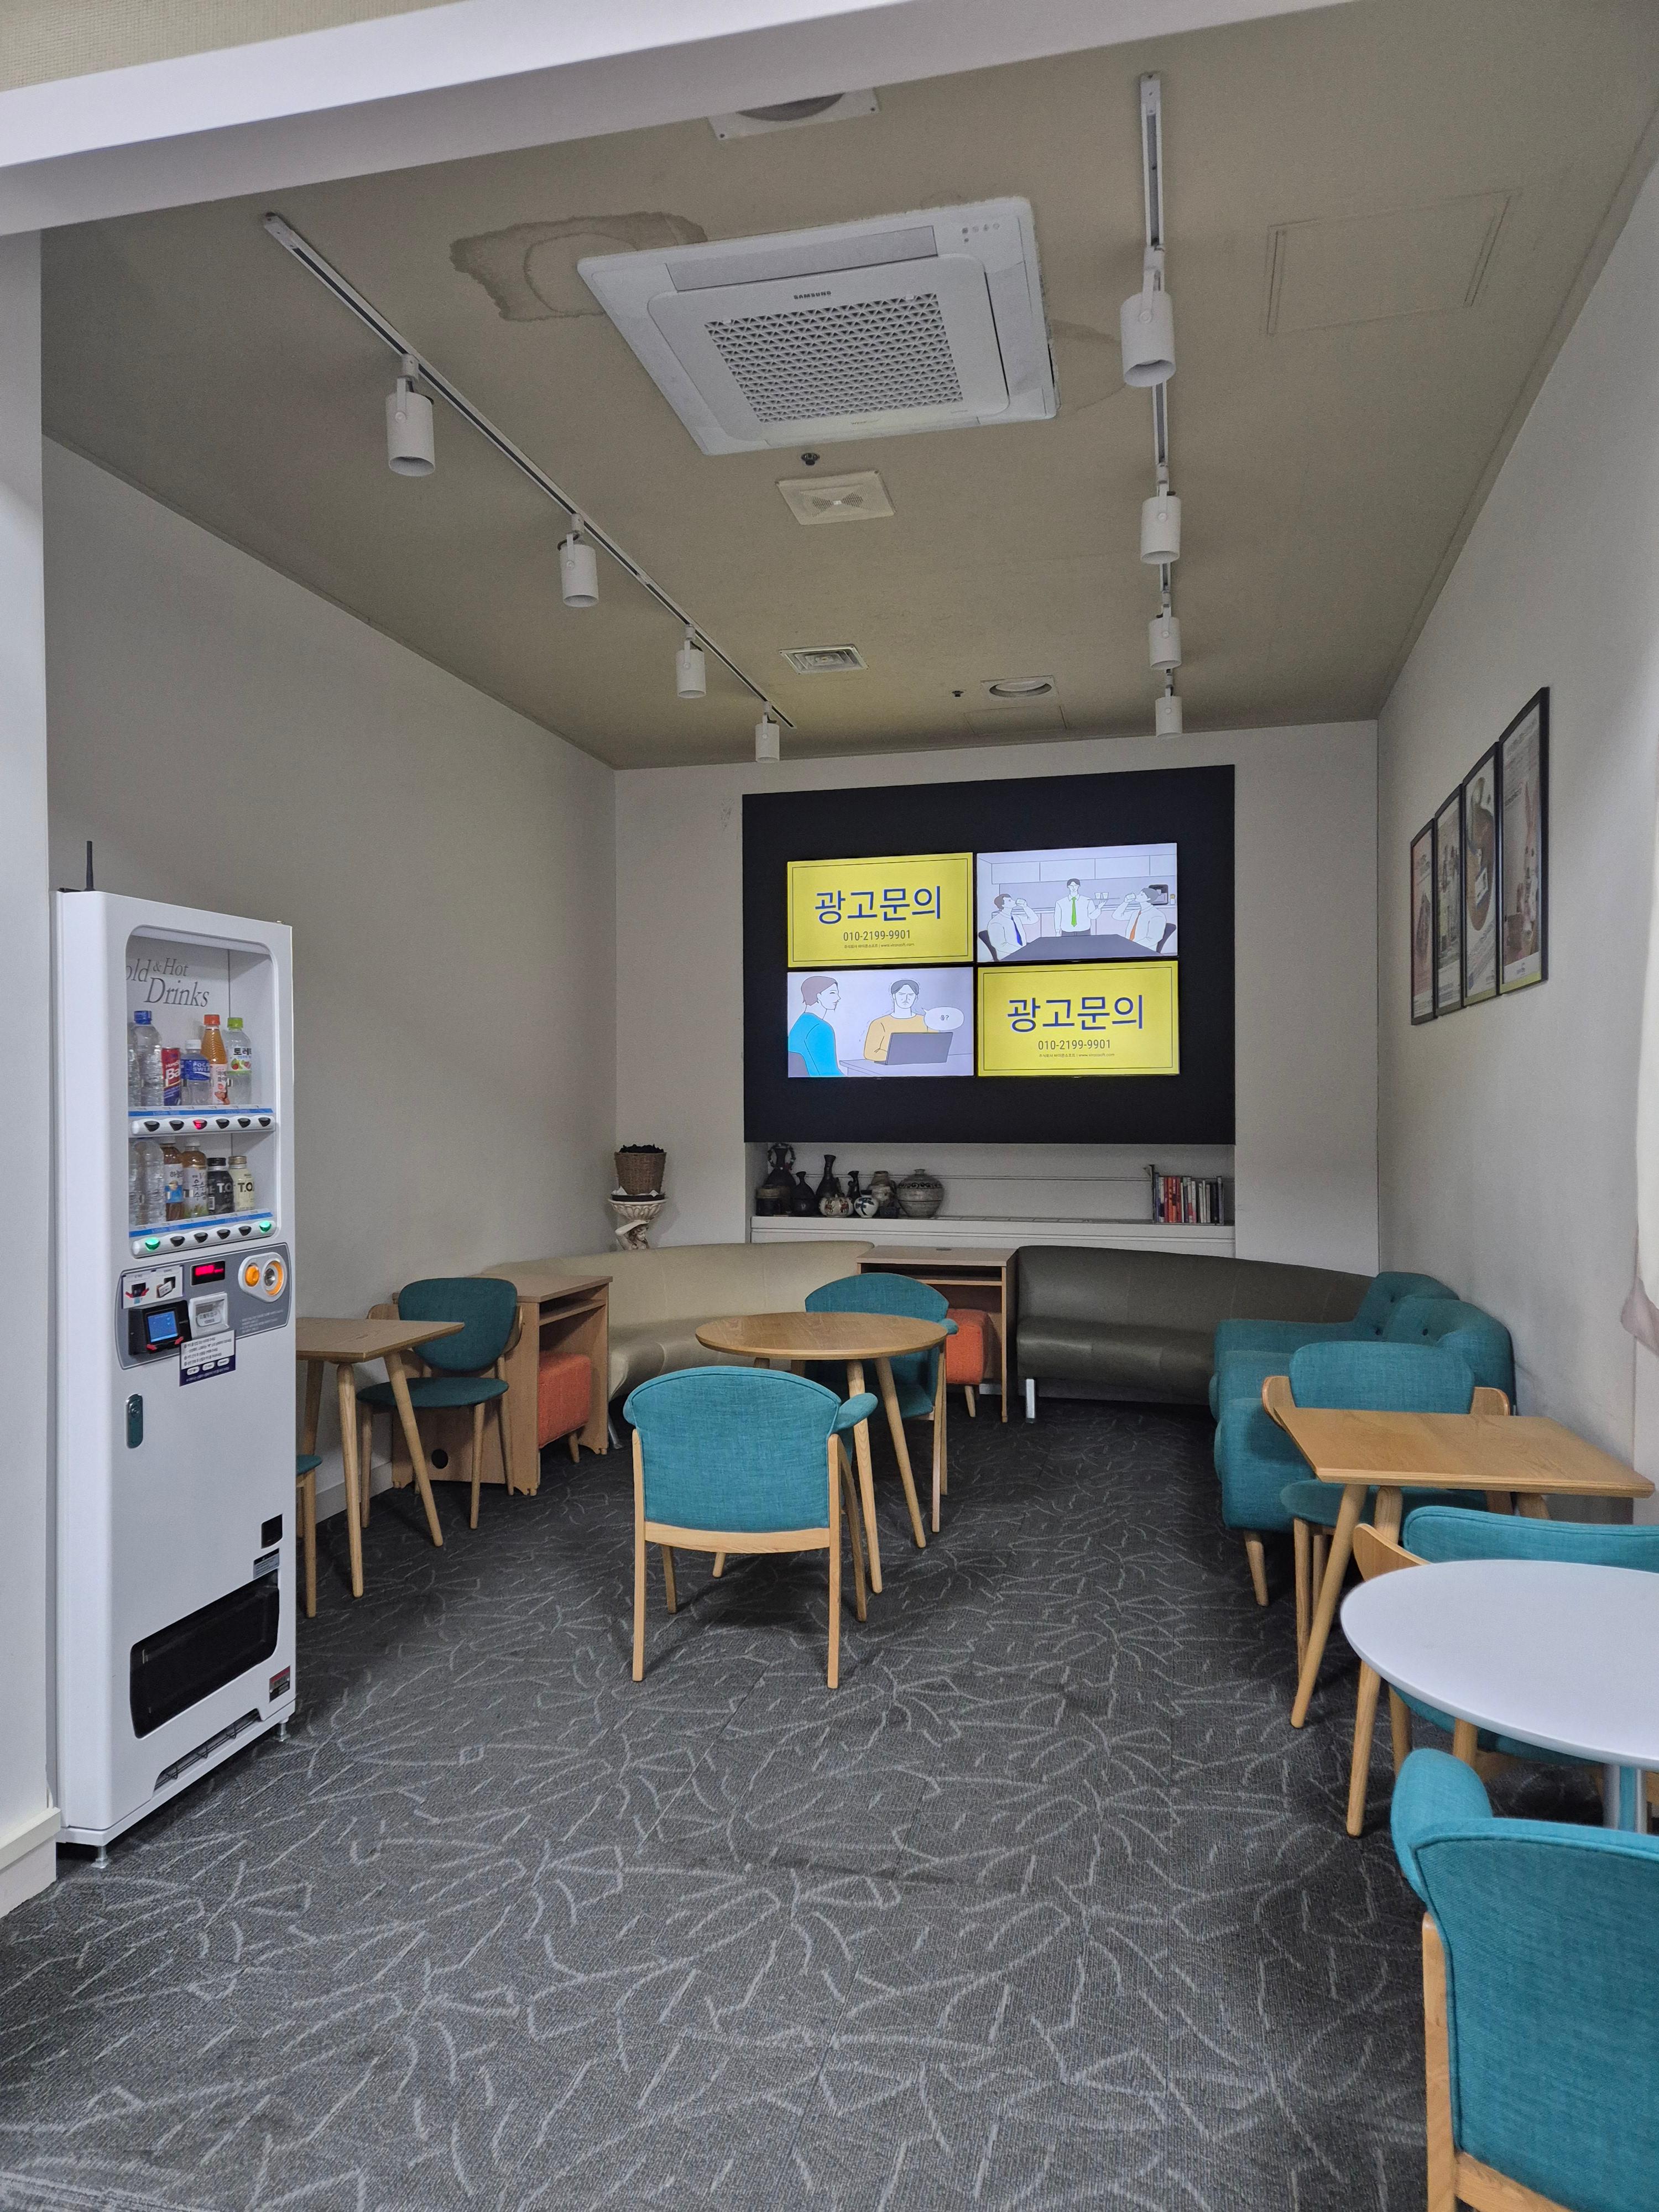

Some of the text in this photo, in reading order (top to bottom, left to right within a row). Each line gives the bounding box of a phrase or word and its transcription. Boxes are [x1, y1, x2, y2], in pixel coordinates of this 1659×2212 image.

[794, 290, 832, 300] SAMSUNG
[815, 886, 940, 924] 광고문의
[843, 930, 910, 941] 010-2199-9901
[126, 958, 152, 982] old
[163, 958, 189, 977] Hot
[143, 977, 210, 1007] Drinks
[1007, 995, 1142, 1032] 광고문의
[1038, 1039, 1110, 1050] 010-2199-9901
